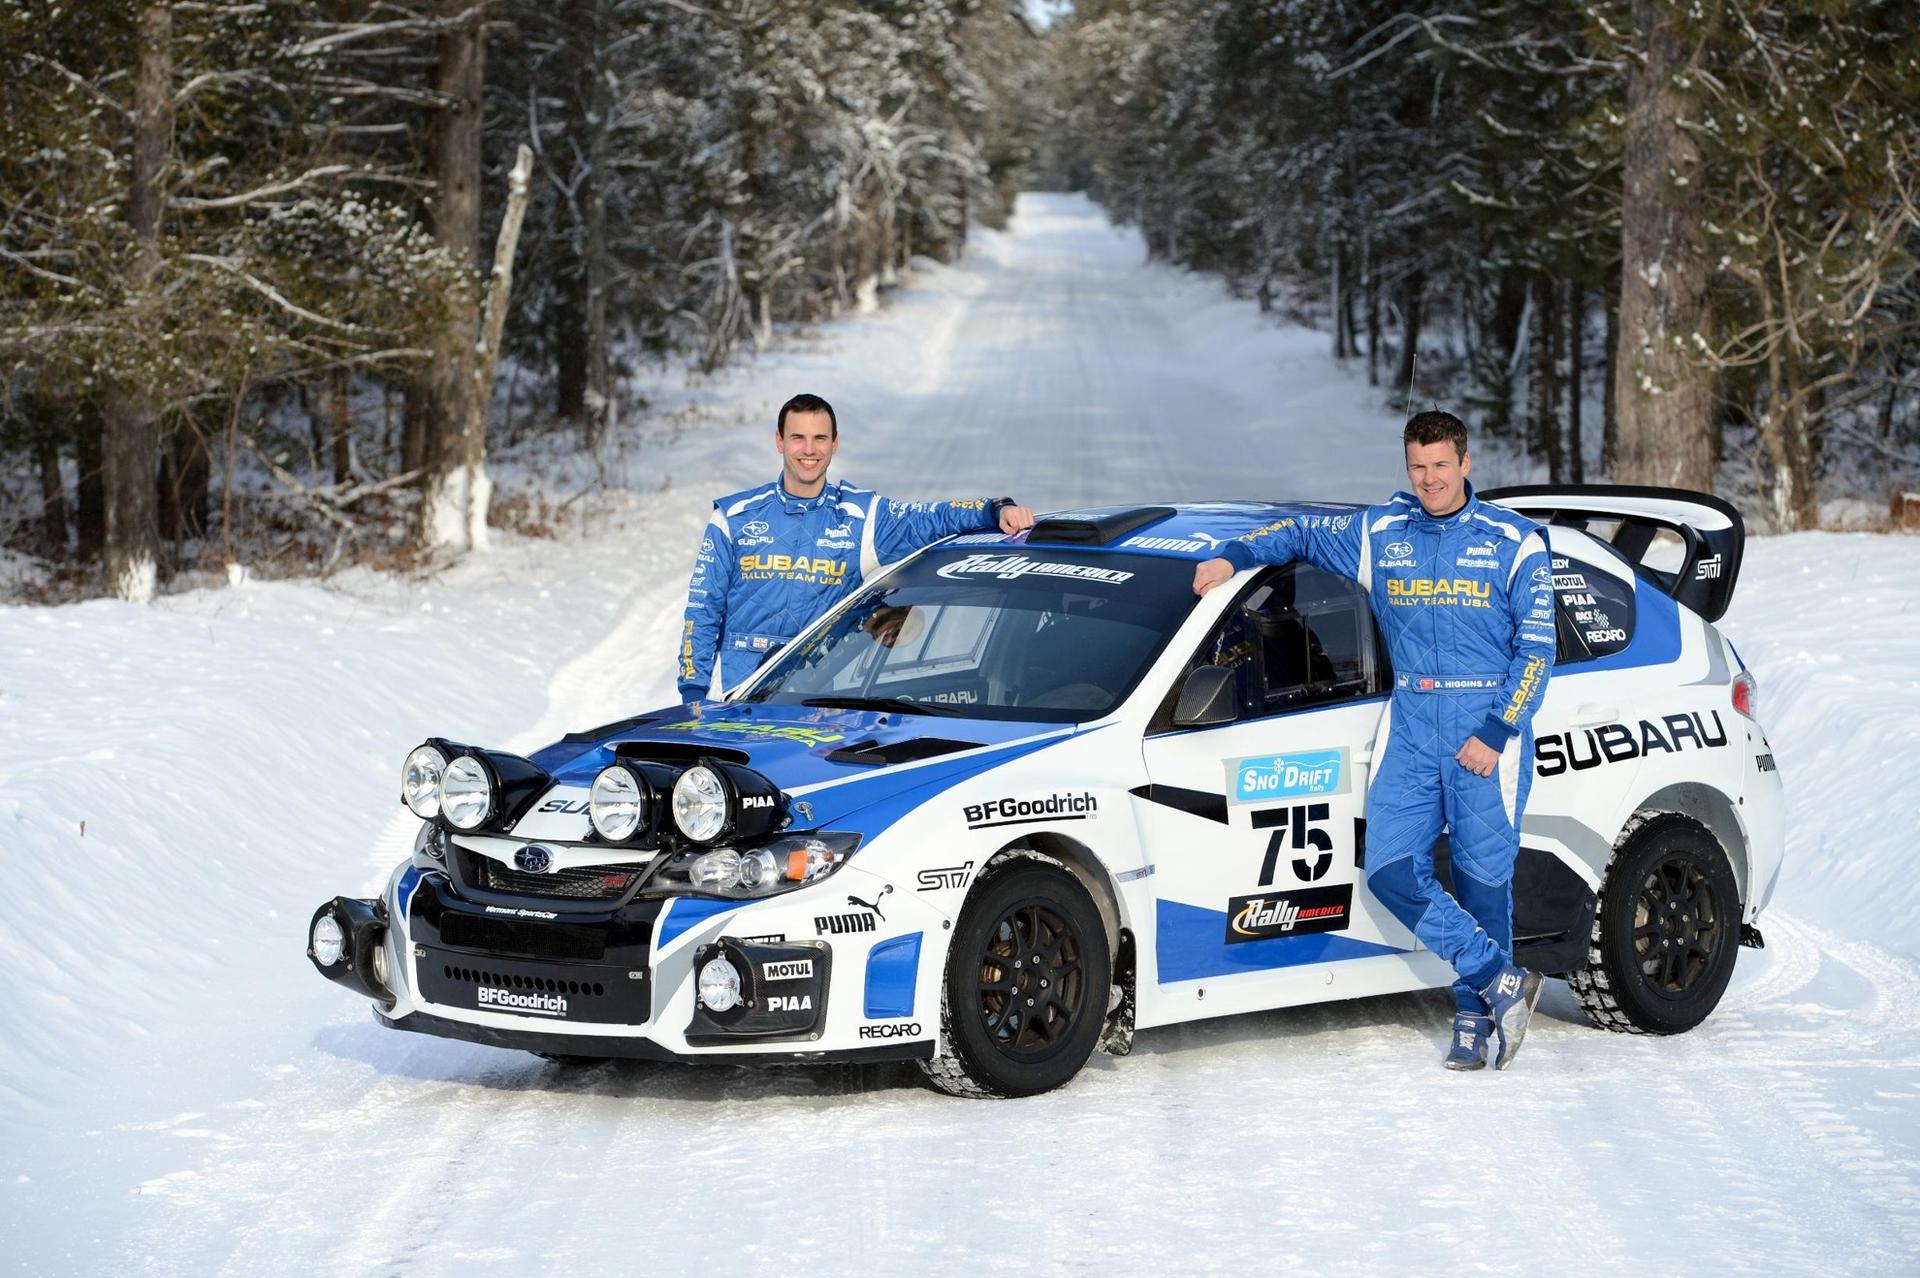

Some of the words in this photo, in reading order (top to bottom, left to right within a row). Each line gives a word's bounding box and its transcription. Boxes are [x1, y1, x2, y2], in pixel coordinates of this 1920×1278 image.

[1120, 536, 1207, 553] PUMA
[739, 554, 847, 577] SUBARU
[946, 553, 1031, 580] Rally
[741, 571, 775, 580] RALLY
[778, 571, 815, 585] TEAM
[819, 577, 843, 586] USA
[1554, 576, 1585, 588] MOTUL
[1386, 579, 1490, 598] SUBARU
[1388, 597, 1419, 606] RALLY
[1421, 597, 1459, 606] TEAM
[1461, 598, 1491, 608] USA
[1562, 593, 1597, 606] PIAA
[1586, 628, 1626, 643] RECARO
[1434, 681, 1443, 689] D.
[1445, 680, 1483, 689] HIGGINS
[1503, 654, 1540, 721] SUBARU
[1534, 709, 1728, 777] SUBARU
[742, 796, 775, 809] PIAA
[963, 792, 1099, 823] BFGoodrich
[1250, 802, 1333, 887] 75
[1241, 898, 1301, 931] Rally
[1297, 904, 1345, 920] AMERICA
[814, 912, 877, 936] PUMA
[767, 962, 811, 978] MOTUL
[1497, 972, 1517, 997] 75
[478, 986, 568, 1011] BFGoodrich
[767, 995, 813, 1012] PIAA
[859, 1022, 922, 1039] RECARO
